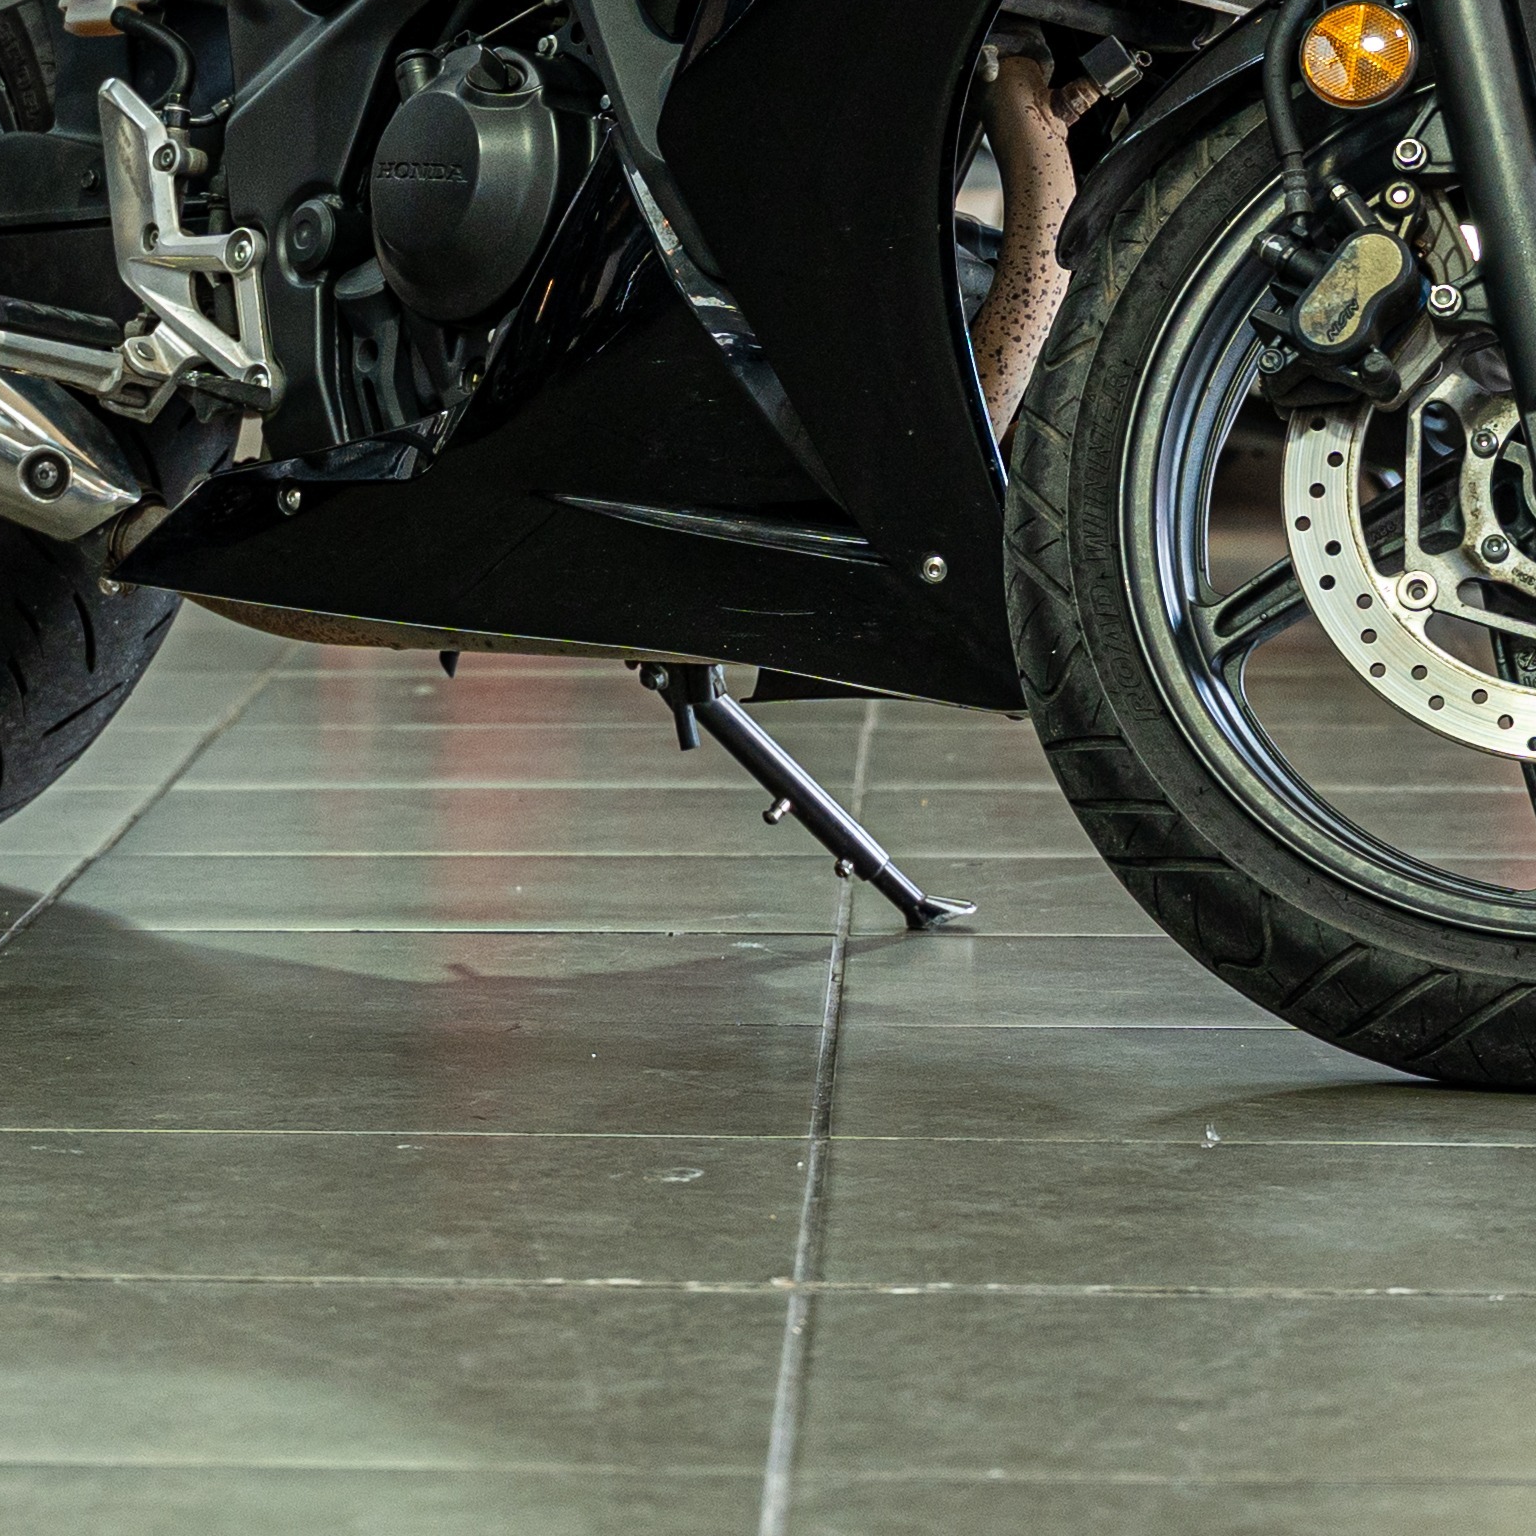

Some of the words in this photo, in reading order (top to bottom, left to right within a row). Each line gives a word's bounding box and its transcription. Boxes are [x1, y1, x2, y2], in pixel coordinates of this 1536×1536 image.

[375, 160, 469, 184] HONDA
[1082, 364, 1131, 562] WINNER
[1088, 584, 1162, 722] ROAD
